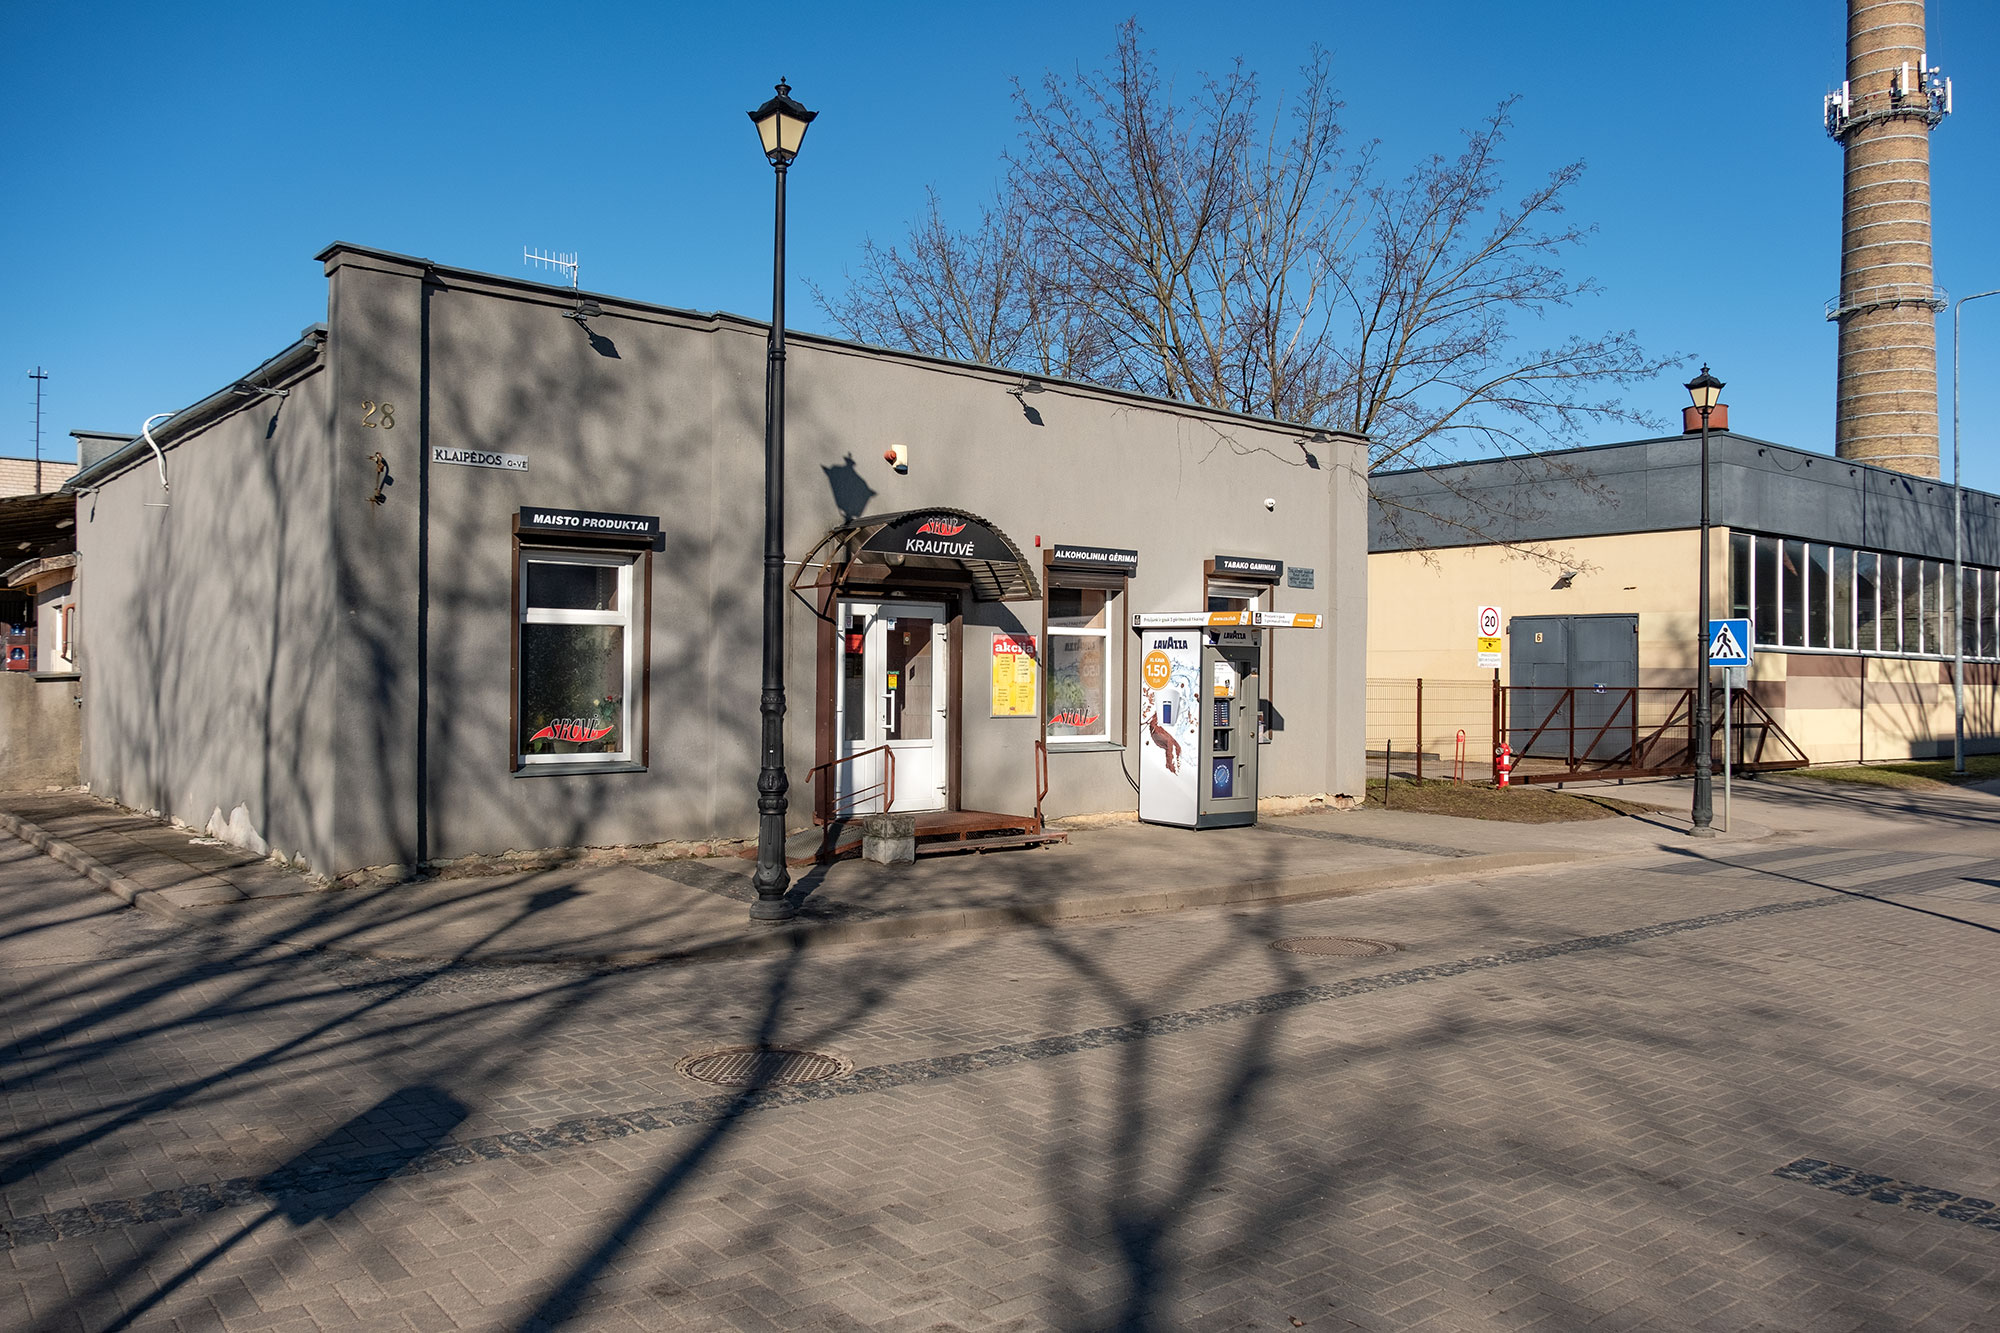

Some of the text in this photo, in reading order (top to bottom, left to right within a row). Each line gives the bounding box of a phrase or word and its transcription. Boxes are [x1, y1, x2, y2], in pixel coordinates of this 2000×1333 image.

[361, 400, 395, 430] 28
[434, 449, 502, 466] KLAIPĖDOS
[533, 514, 649, 531] MAISTO PRODUKTAI
[905, 538, 975, 556] KRAUTUVĖ
[1055, 550, 1137, 563] ALKOHOLINIAI GĖRIMAI
[1224, 560, 1276, 571] TABAKO GAMINIAI
[1485, 616, 1496, 627] 20
[1223, 630, 1247, 640] LAVAZZA
[994, 641, 1034, 654] akcija
[1153, 636, 1188, 649] LAVAZZA
[1146, 664, 1168, 677] 1.50
